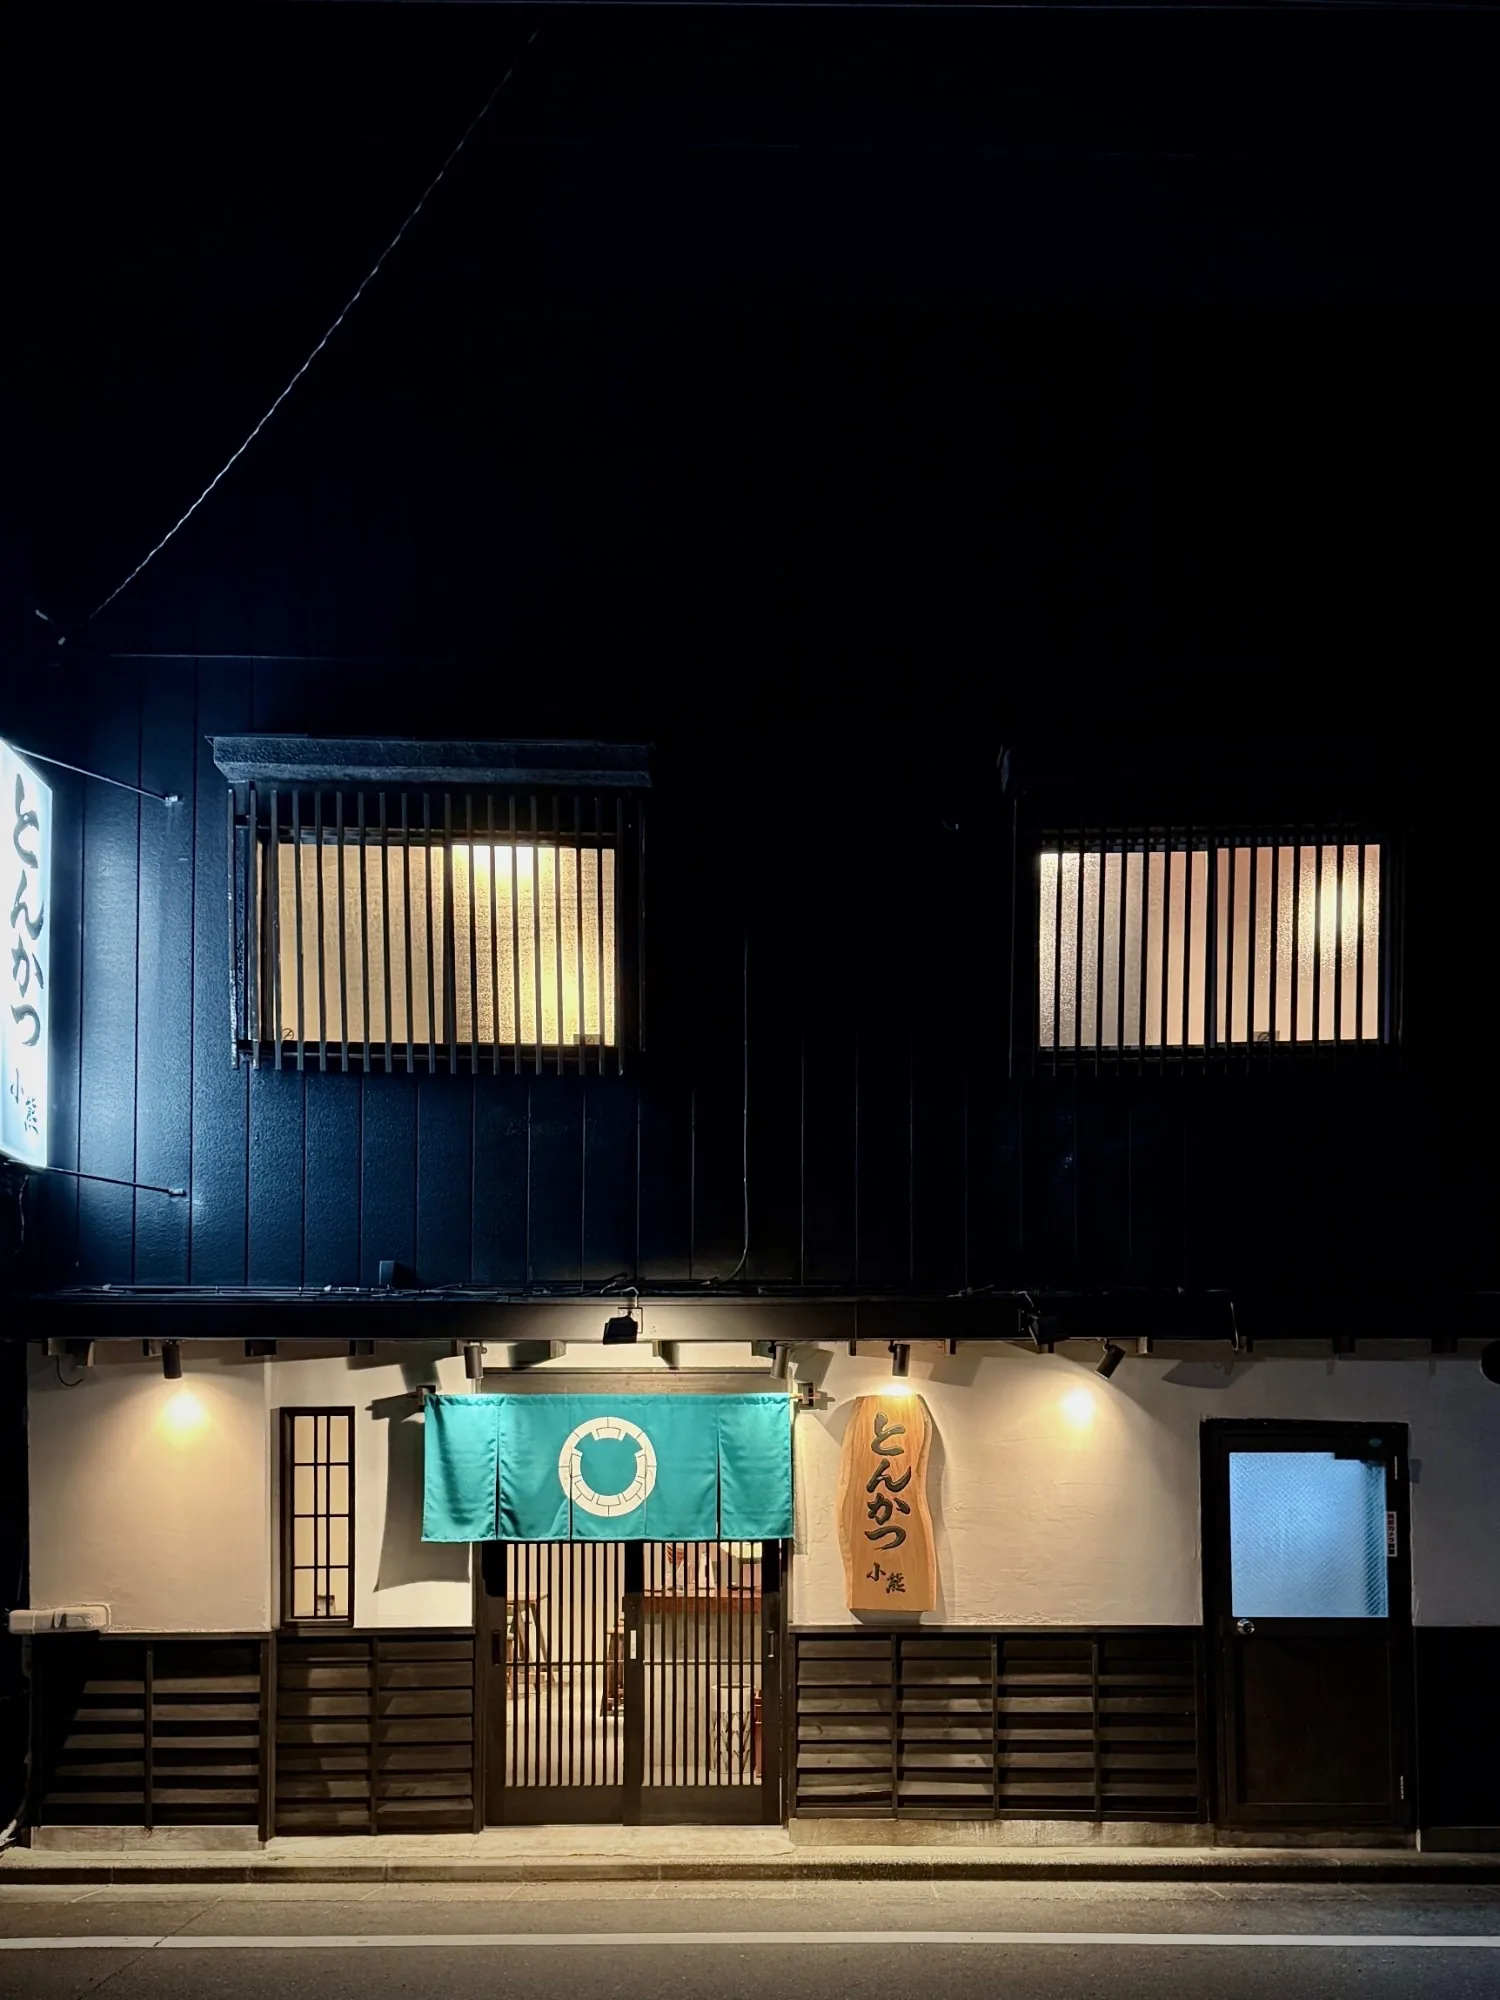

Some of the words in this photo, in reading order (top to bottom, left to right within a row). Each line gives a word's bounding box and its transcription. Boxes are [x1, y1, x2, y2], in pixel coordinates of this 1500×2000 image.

[11, 774, 44, 1047] とんかつ
[865, 1412, 911, 1551] とんかつ
